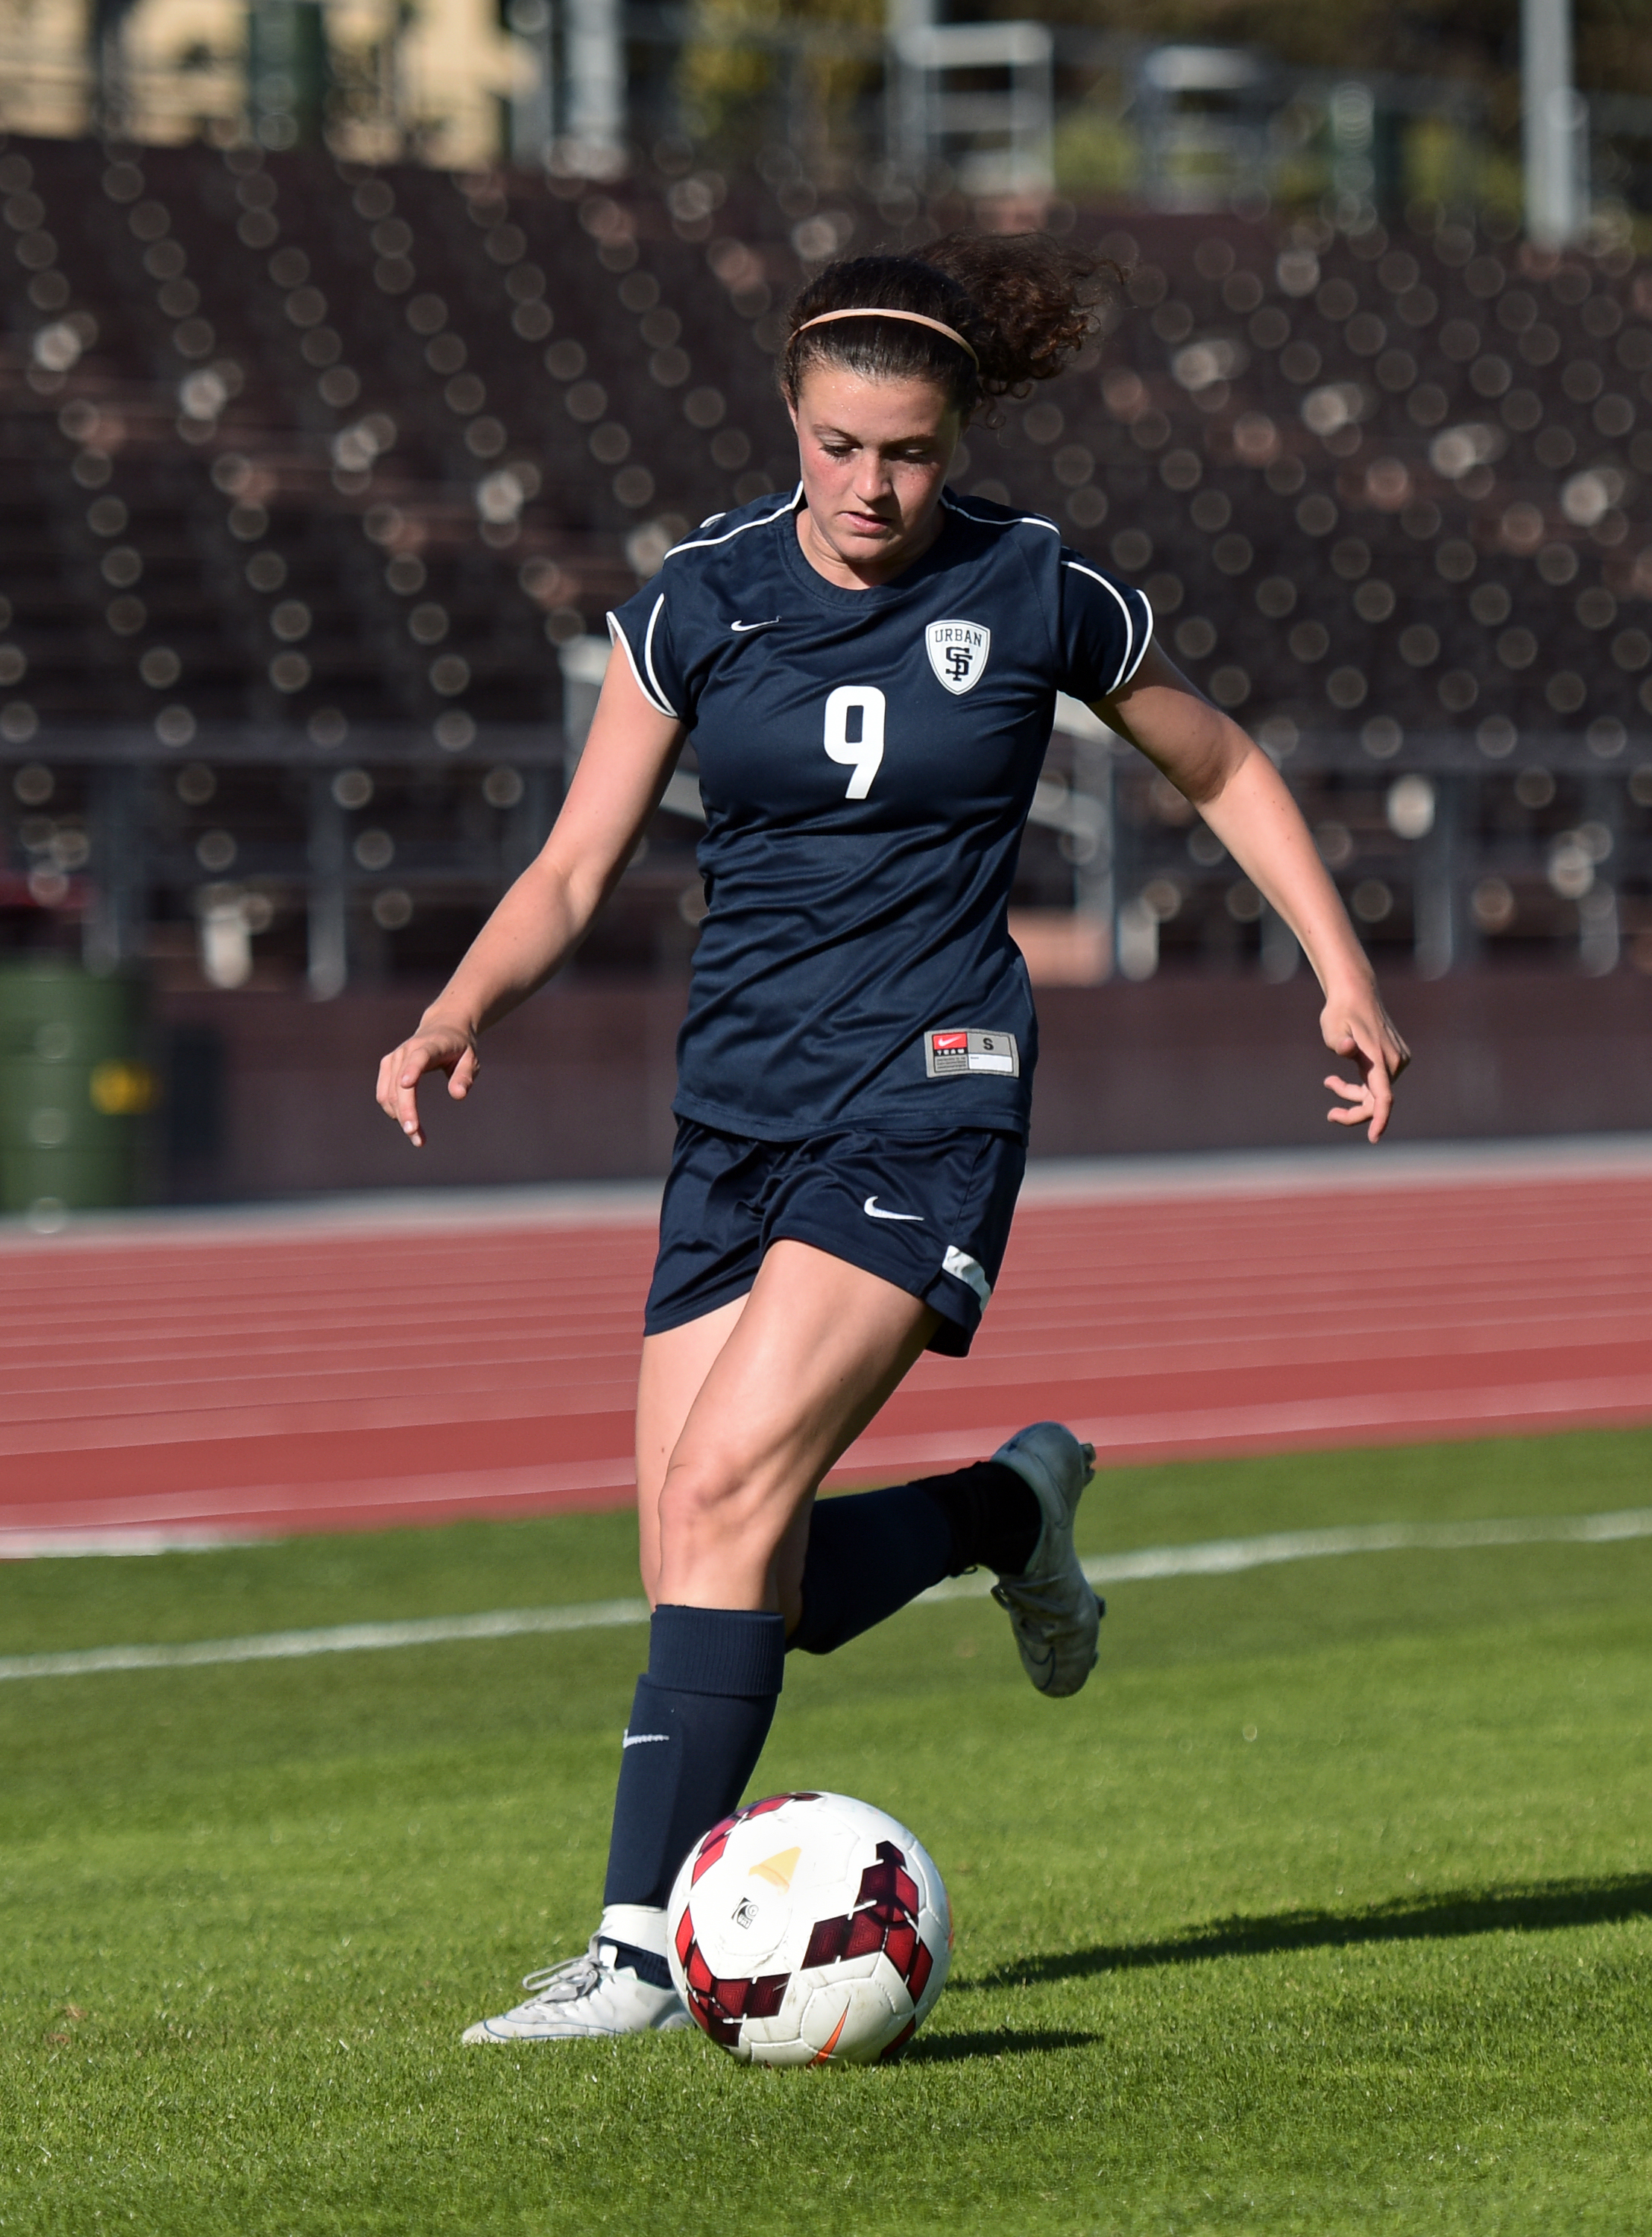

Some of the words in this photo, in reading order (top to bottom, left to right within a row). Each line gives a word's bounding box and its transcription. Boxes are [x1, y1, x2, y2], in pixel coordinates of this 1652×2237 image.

[935, 629, 982, 647] URBAN
[824, 685, 886, 799] 9
[983, 1038, 994, 1051] S
